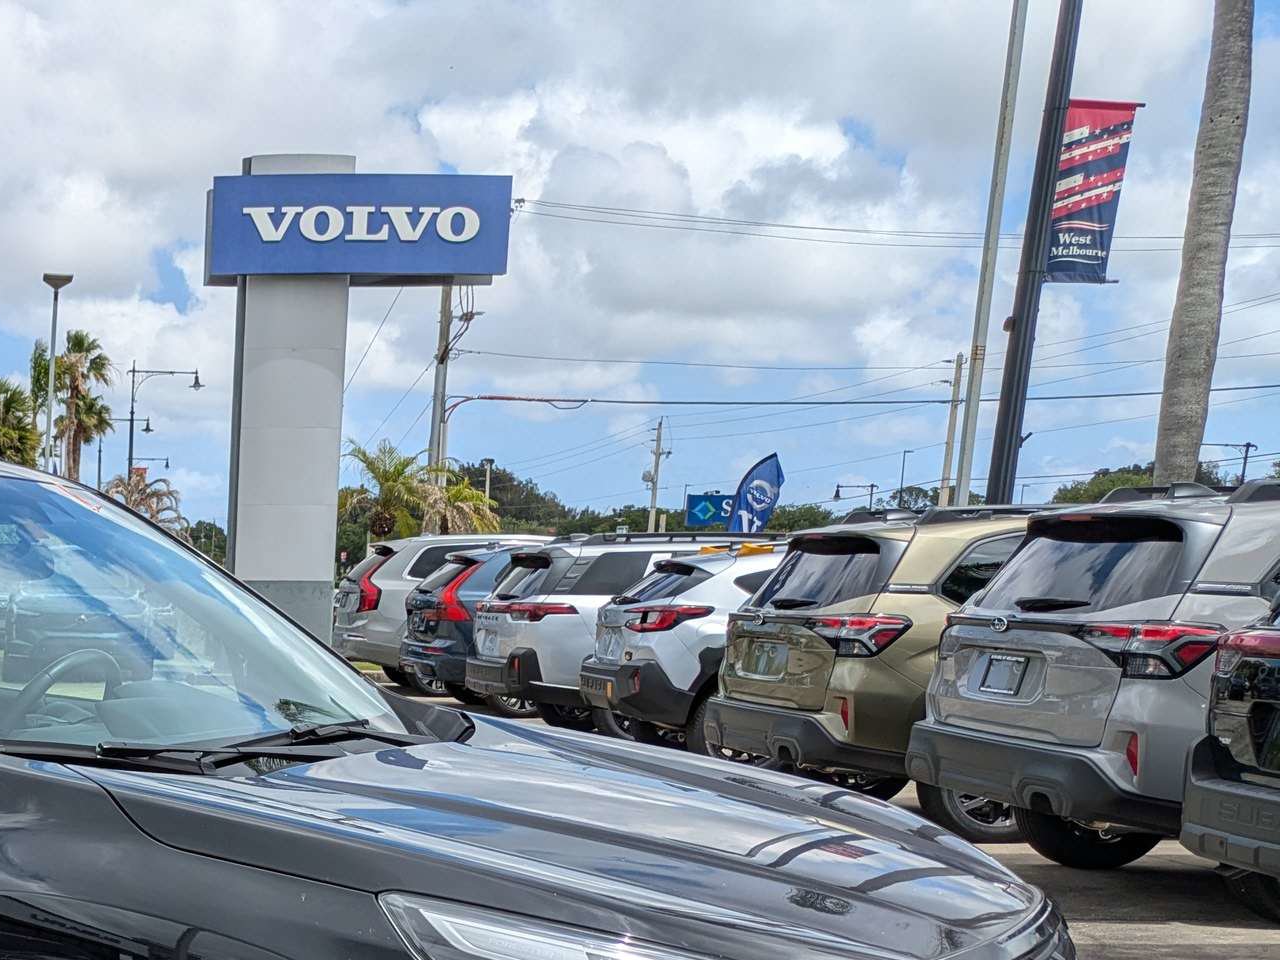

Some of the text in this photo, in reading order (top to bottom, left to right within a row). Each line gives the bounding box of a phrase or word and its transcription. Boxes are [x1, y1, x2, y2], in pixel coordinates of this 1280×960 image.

[242, 205, 480, 243] VOLVO
[1058, 232, 1092, 244] West
[1050, 246, 1107, 258] Melbourne
